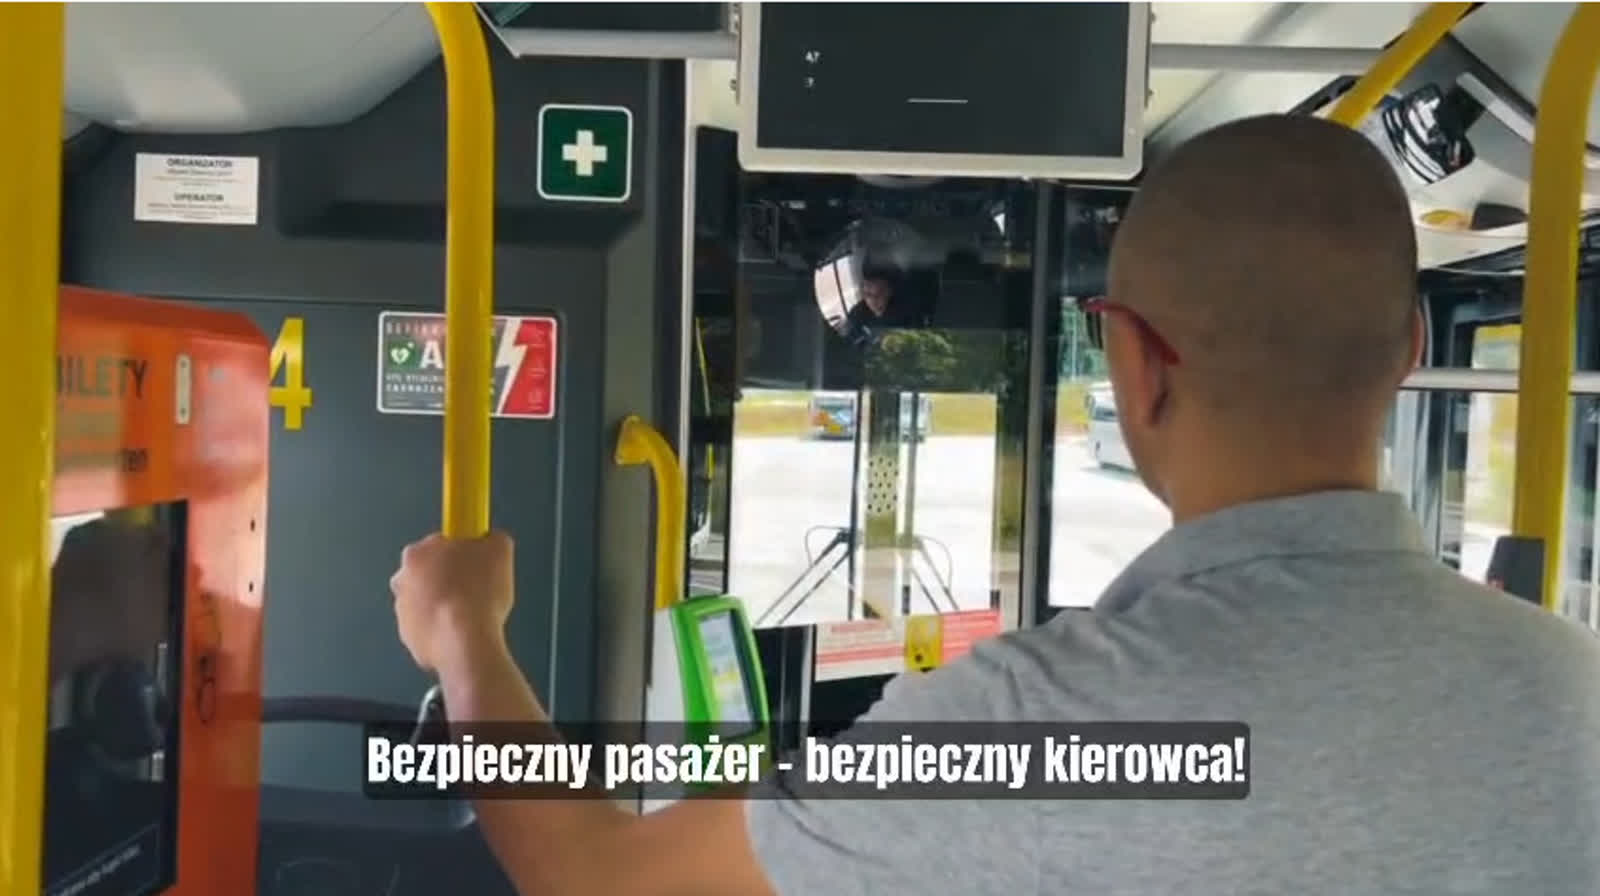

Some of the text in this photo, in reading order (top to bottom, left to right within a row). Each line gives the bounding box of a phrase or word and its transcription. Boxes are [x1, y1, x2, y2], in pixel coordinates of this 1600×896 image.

[167, 157, 233, 168] ORGANIZATOR
[174, 192, 224, 202] OPERATOR
[419, 339, 446, 369] A
[268, 317, 312, 430] 4
